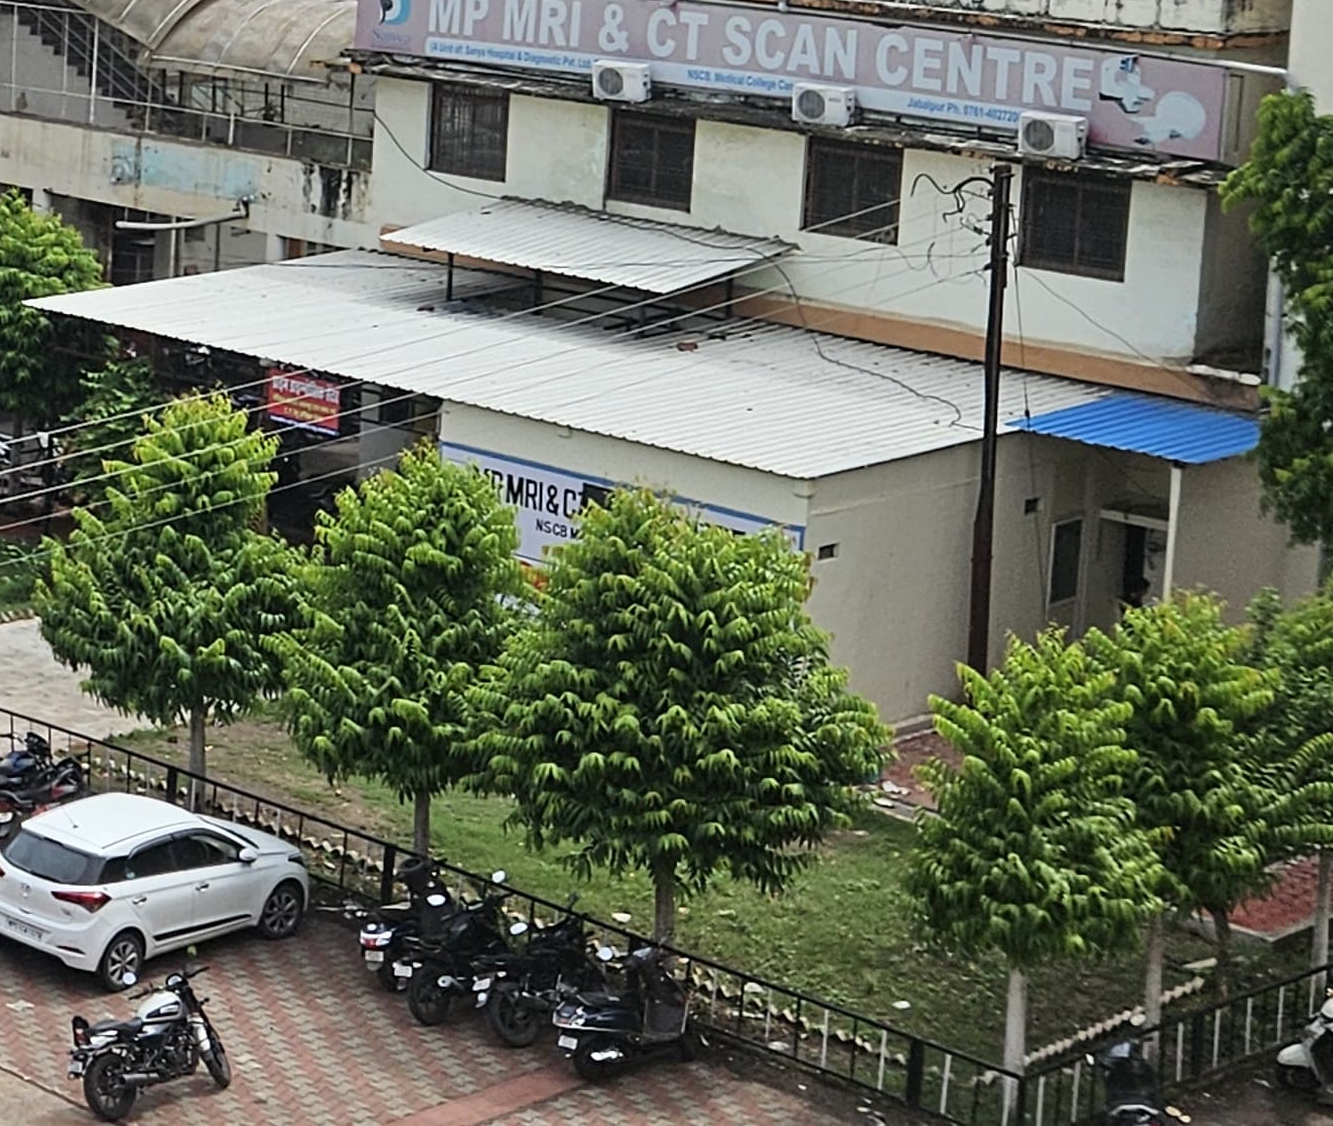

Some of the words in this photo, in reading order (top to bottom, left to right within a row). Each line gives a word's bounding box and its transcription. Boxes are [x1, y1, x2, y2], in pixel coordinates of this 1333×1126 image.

[598, 3, 629, 53] &
[647, 8, 709, 60] CT
[722, 16, 858, 80] SCAN
[876, 34, 1094, 112] CENTRE
[714, 72, 744, 85] Medical
[746, 76, 776, 91] College
[907, 98, 945, 112] Jabalpur
[506, 474, 543, 512] MRI
[546, 485, 559, 516] &
[536, 518, 567, 539] NSCB
